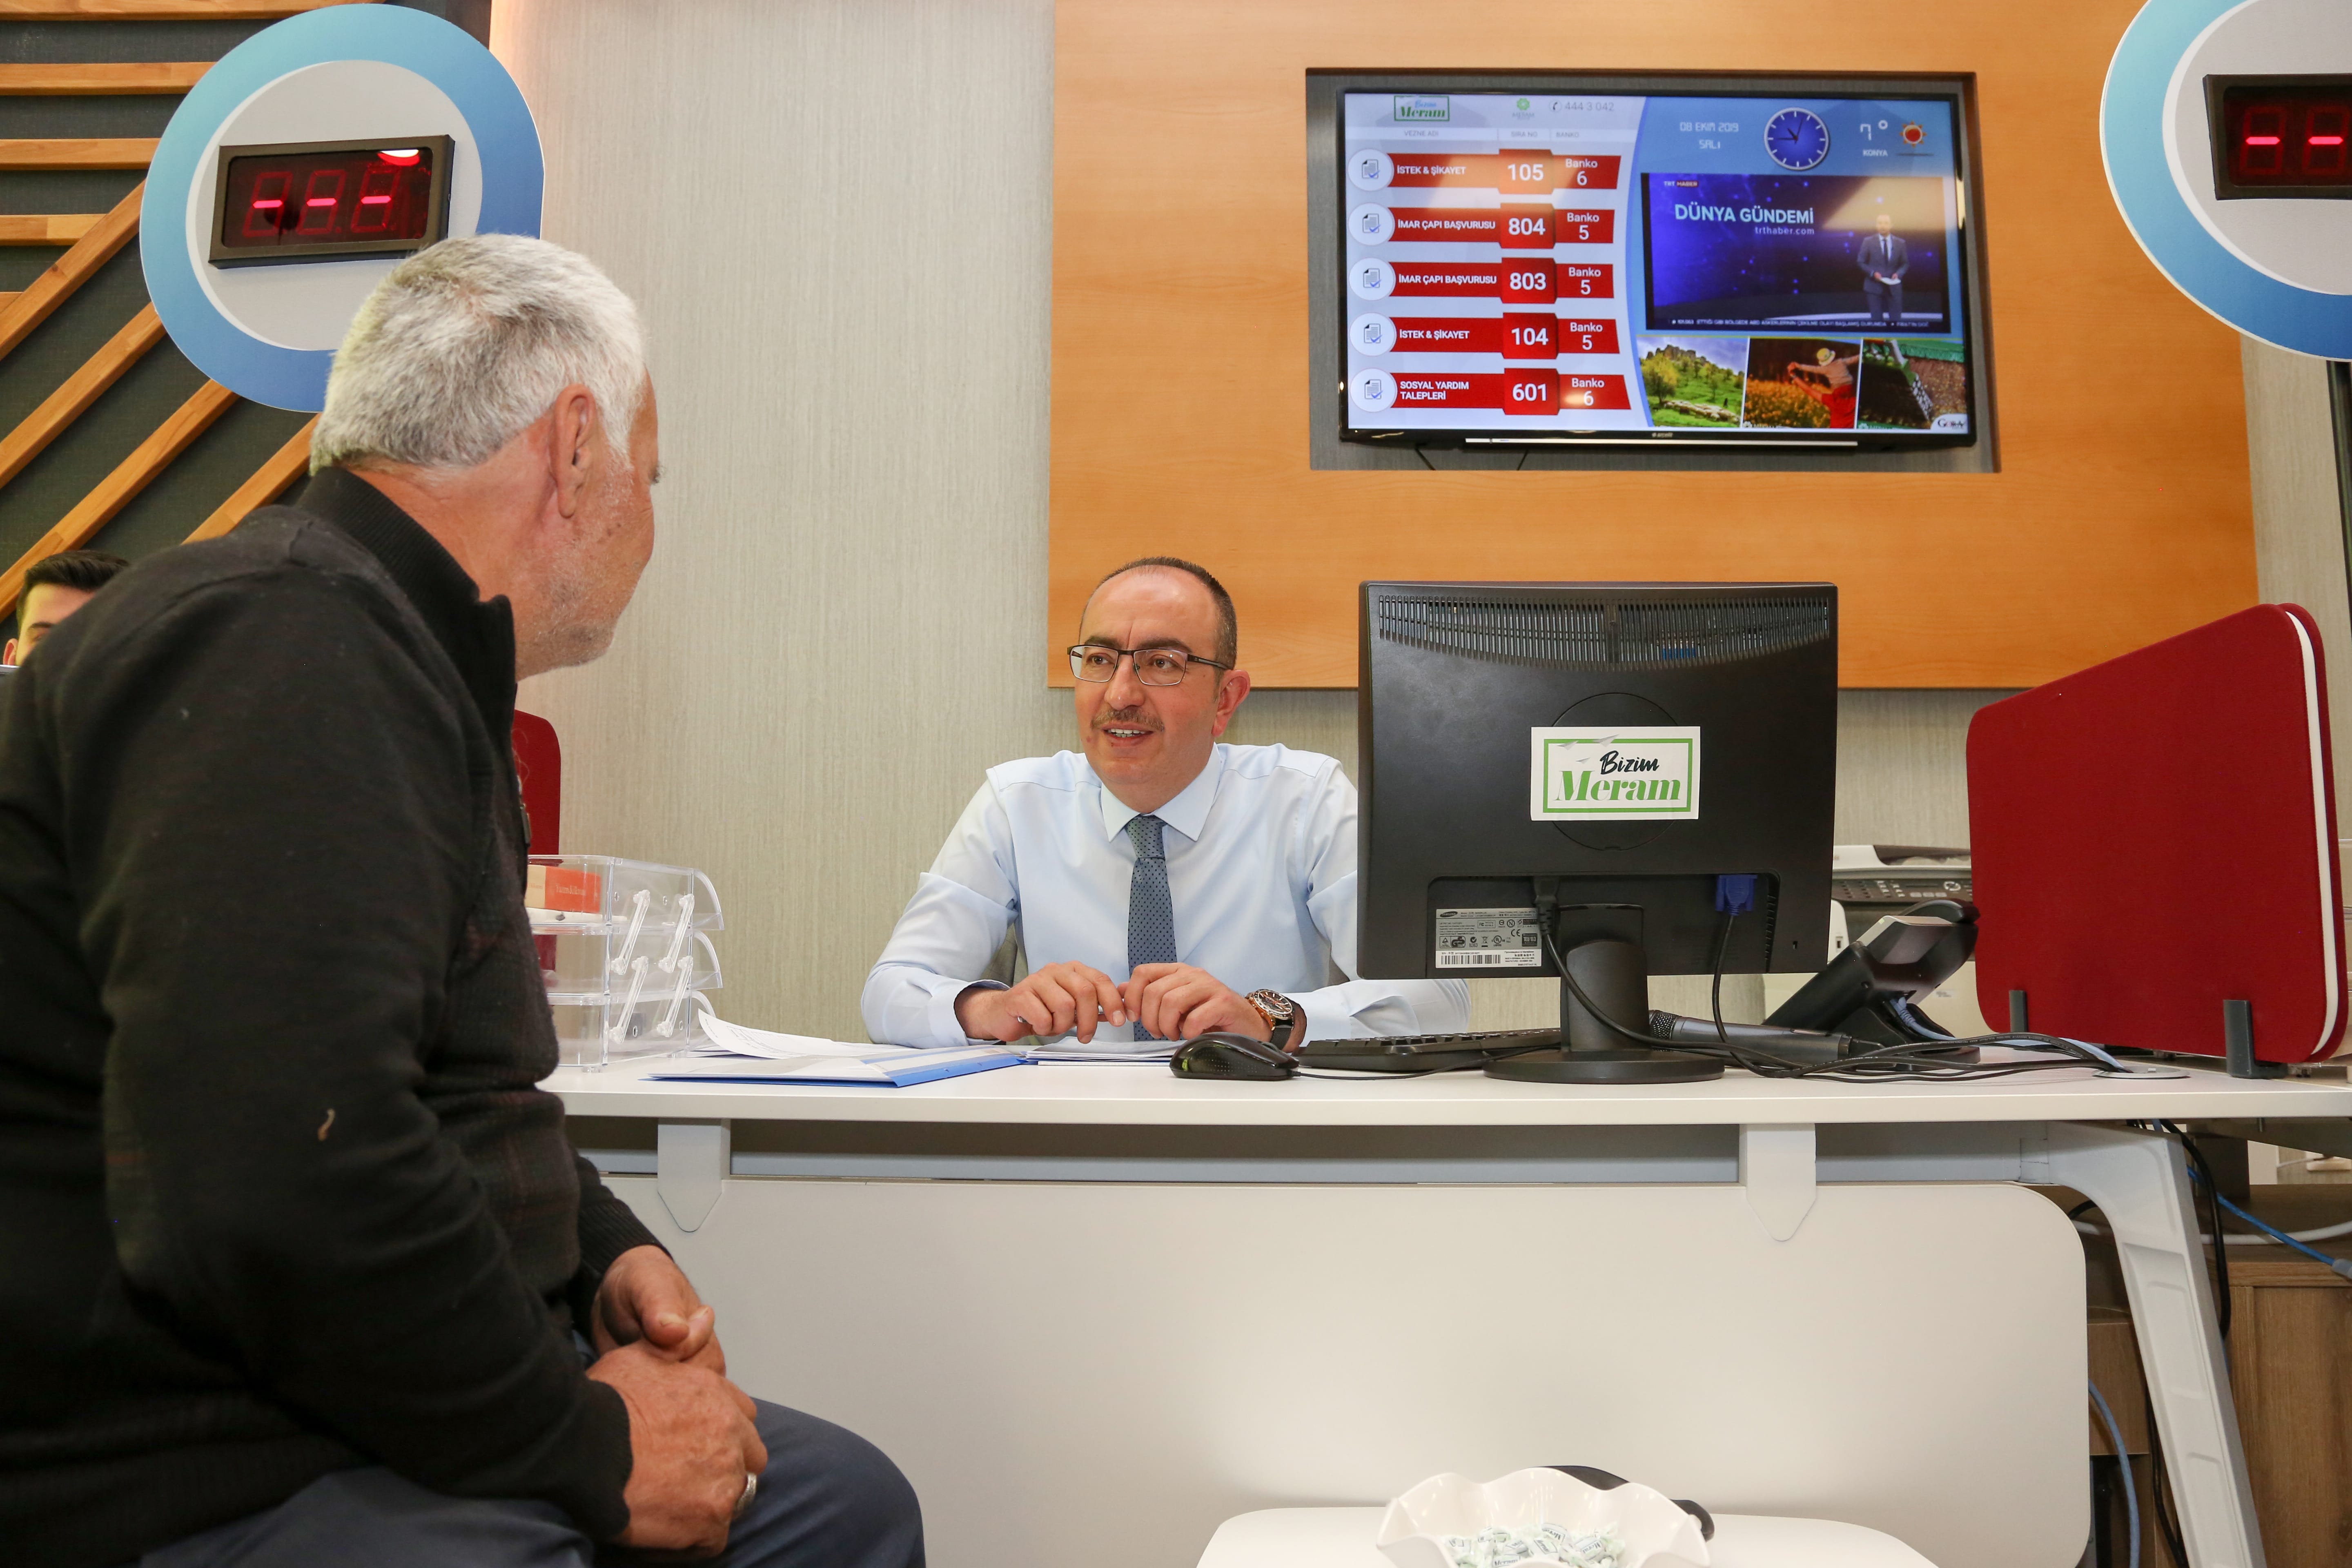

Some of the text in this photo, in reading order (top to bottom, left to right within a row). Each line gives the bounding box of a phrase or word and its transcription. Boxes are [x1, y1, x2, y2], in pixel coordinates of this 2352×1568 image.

[1399, 106, 1446, 117] Meram
[1565, 102, 1614, 111] 444 3 042
[1718, 122, 1739, 132] 2019
[1566, 158, 1598, 169] Banko
[1397, 165, 1466, 176] İSTEK & ŞİKAYET
[1508, 164, 1544, 181] 105
[1577, 172, 1588, 186] 6
[1567, 212, 1599, 223] Banko
[1675, 201, 1814, 224] DÜNYA GÜNDEMİ
[1398, 218, 1496, 231] İMAR ÇAPI BAŞVURUSU
[1508, 217, 1546, 236] 804
[1579, 225, 1589, 240] 5
[1755, 227, 1815, 235] trthaber.com
[1568, 267, 1601, 277] Banko
[1399, 274, 1497, 286] İMAR ÇAPI BAŞVURUSU
[1510, 272, 1546, 291] 803
[1580, 280, 1591, 295] 5
[1570, 322, 1603, 333] Banko
[1400, 329, 1470, 341] İSTEK & ŞİKAYET
[1511, 328, 1548, 346] 104
[1582, 335, 1592, 350] 5
[1400, 381, 1469, 390] SOSYAL YARDIM
[1571, 378, 1605, 388] Banko
[1400, 390, 1446, 400] TALEPLERİ
[1512, 383, 1547, 402] 601
[1583, 391, 1594, 406] 6
[1599, 751, 1659, 775] Bizim
[1553, 770, 1681, 801] Meram
